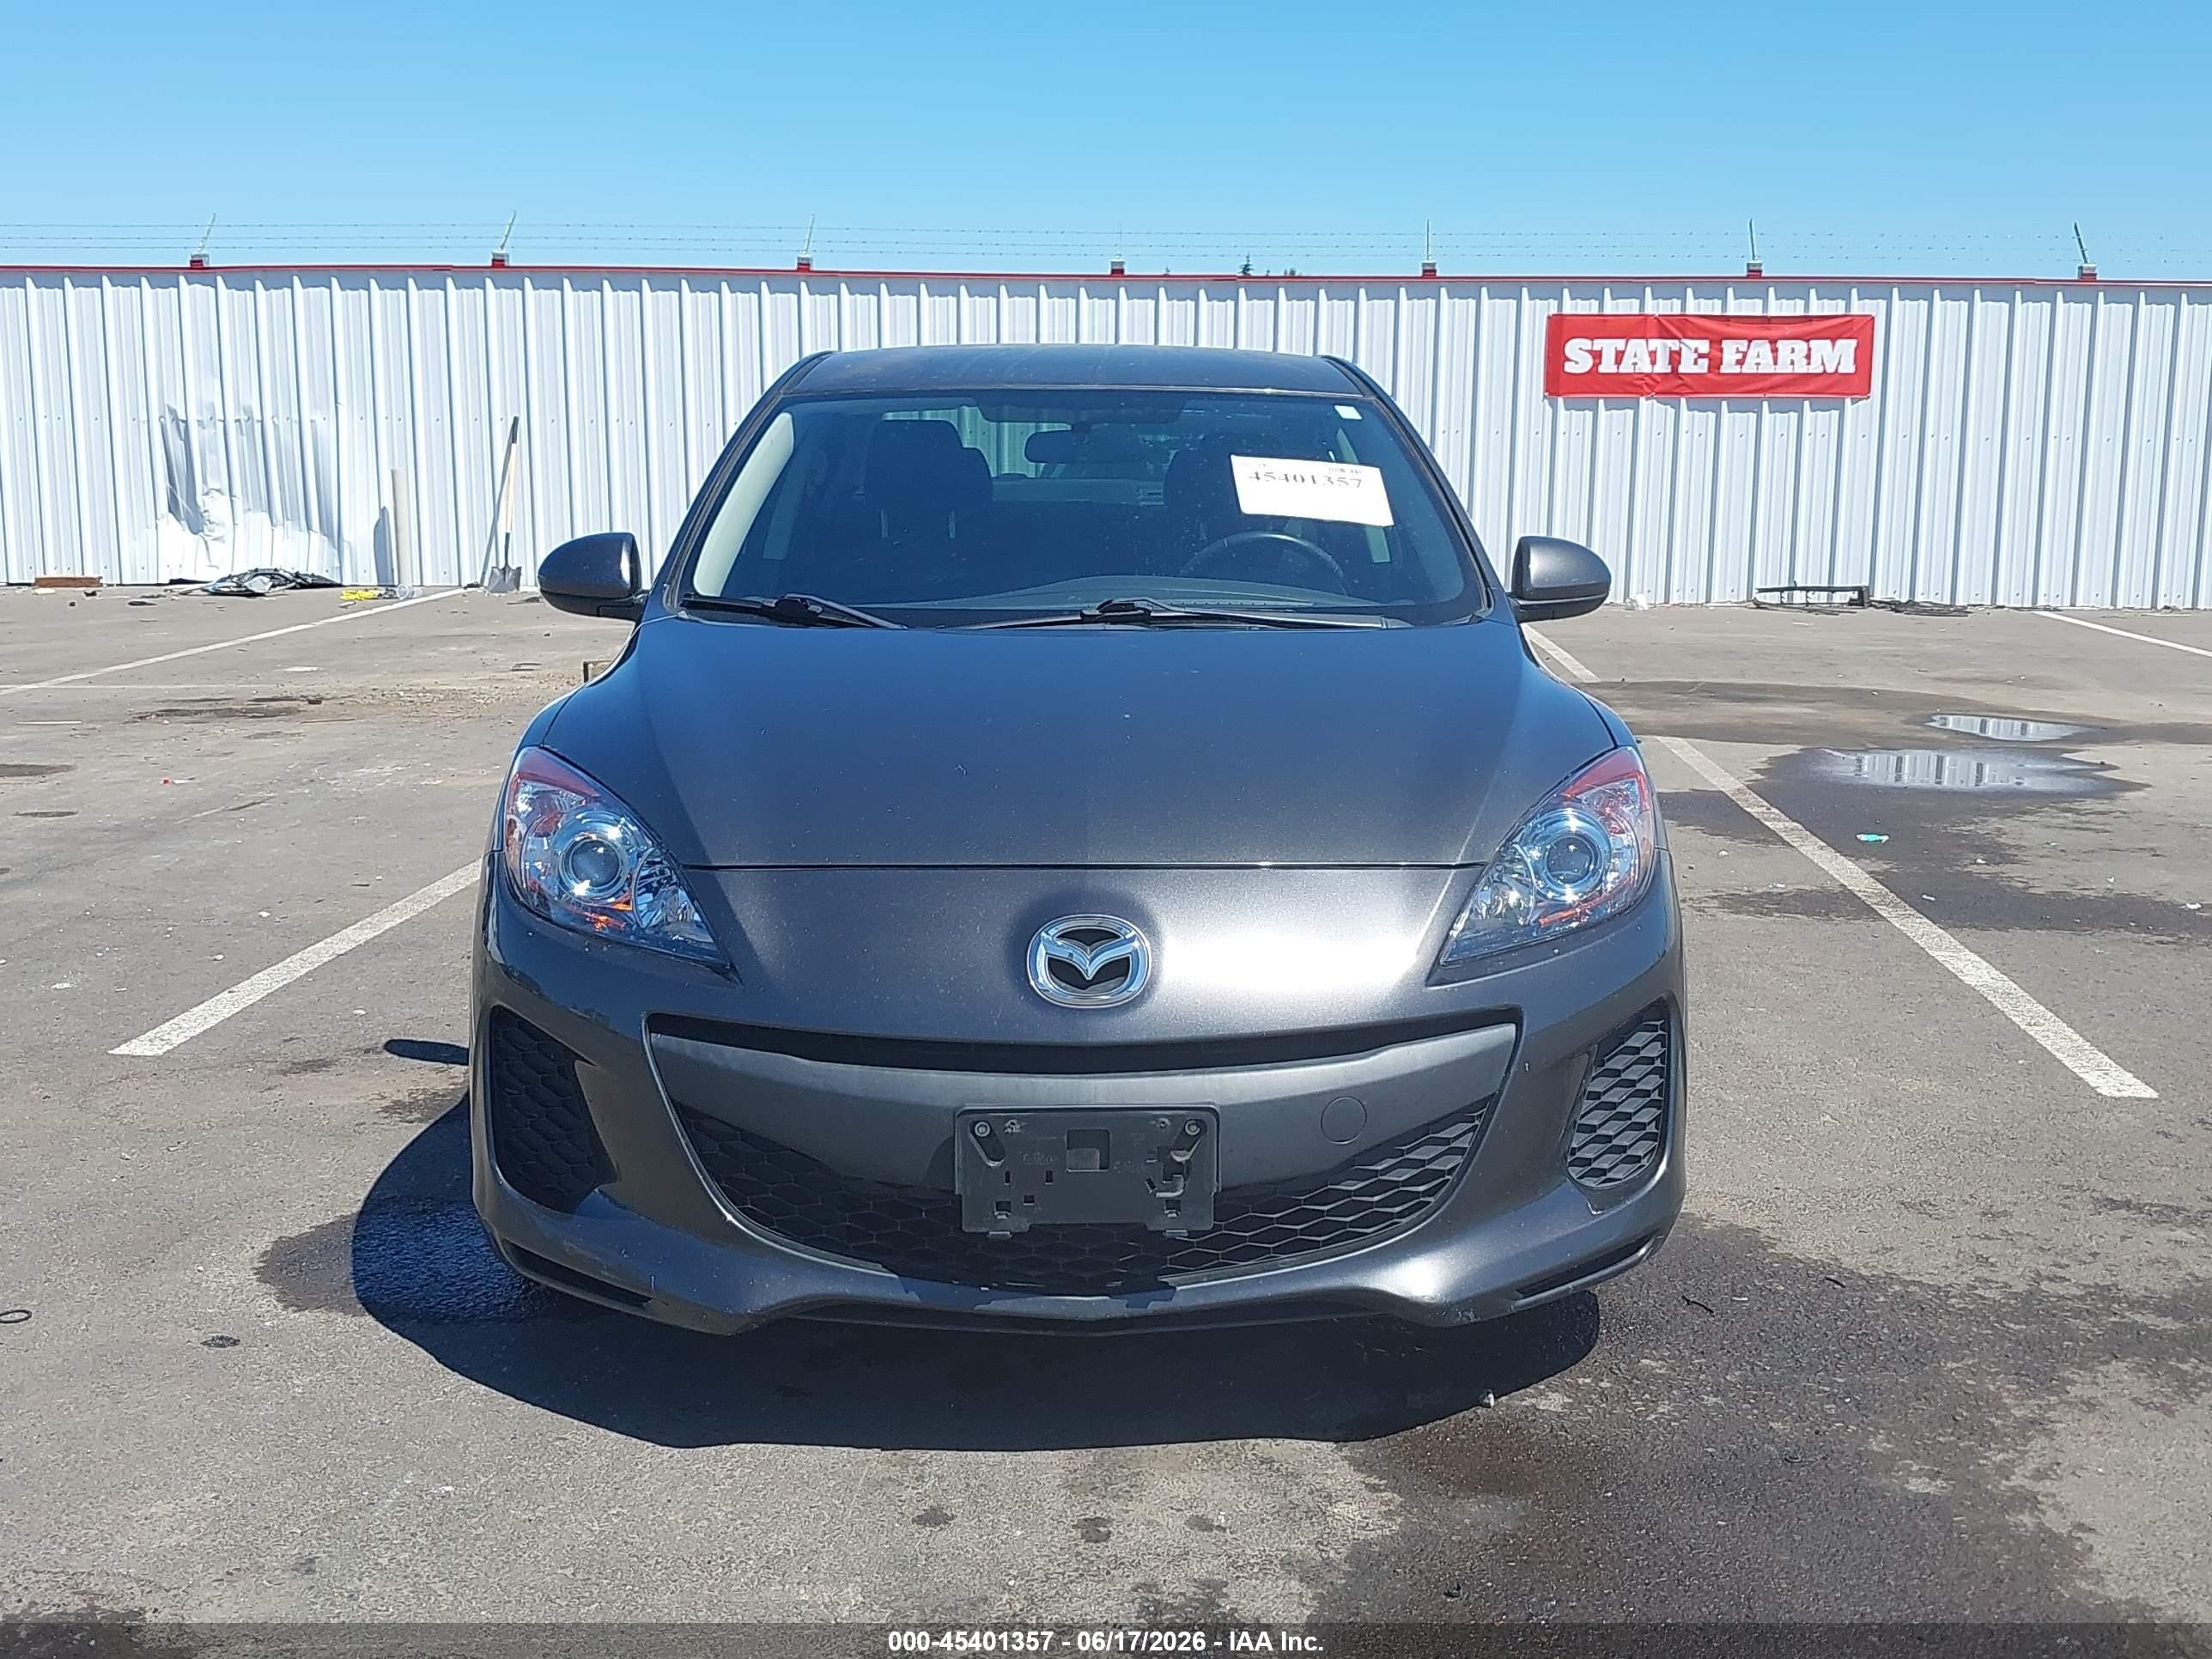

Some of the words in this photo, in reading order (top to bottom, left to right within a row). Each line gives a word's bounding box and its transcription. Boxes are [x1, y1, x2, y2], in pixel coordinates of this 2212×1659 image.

[1563, 337, 1711, 374] STATE
[1719, 337, 1858, 374] FARM
[1249, 471, 1363, 489] 45401357
